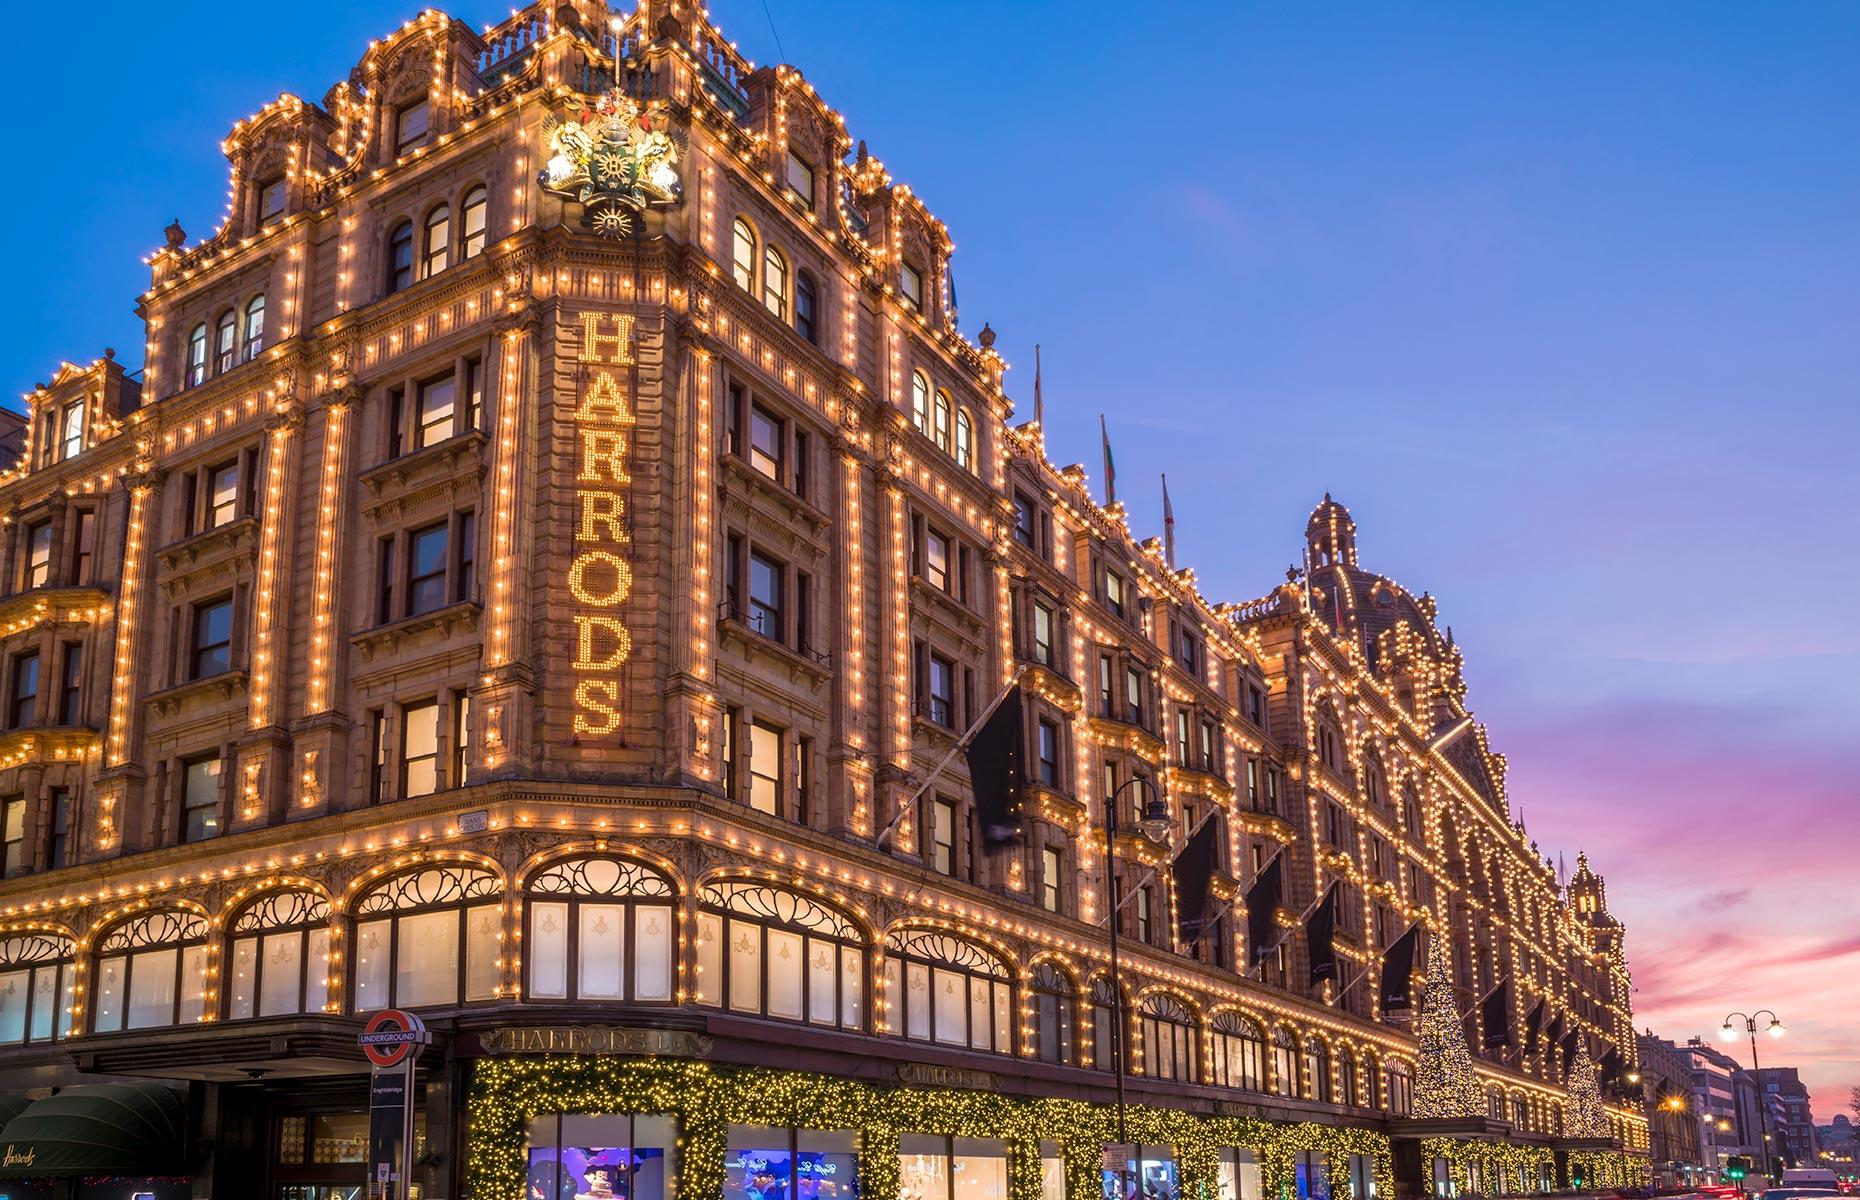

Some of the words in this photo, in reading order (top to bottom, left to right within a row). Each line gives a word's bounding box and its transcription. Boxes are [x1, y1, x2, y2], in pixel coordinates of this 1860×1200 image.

[568, 311, 636, 735] HARRODS
[360, 1033, 415, 1043] UNDERGROUND
[510, 1030, 646, 1051] HARRODS
[2, 1144, 36, 1168] Harrods
